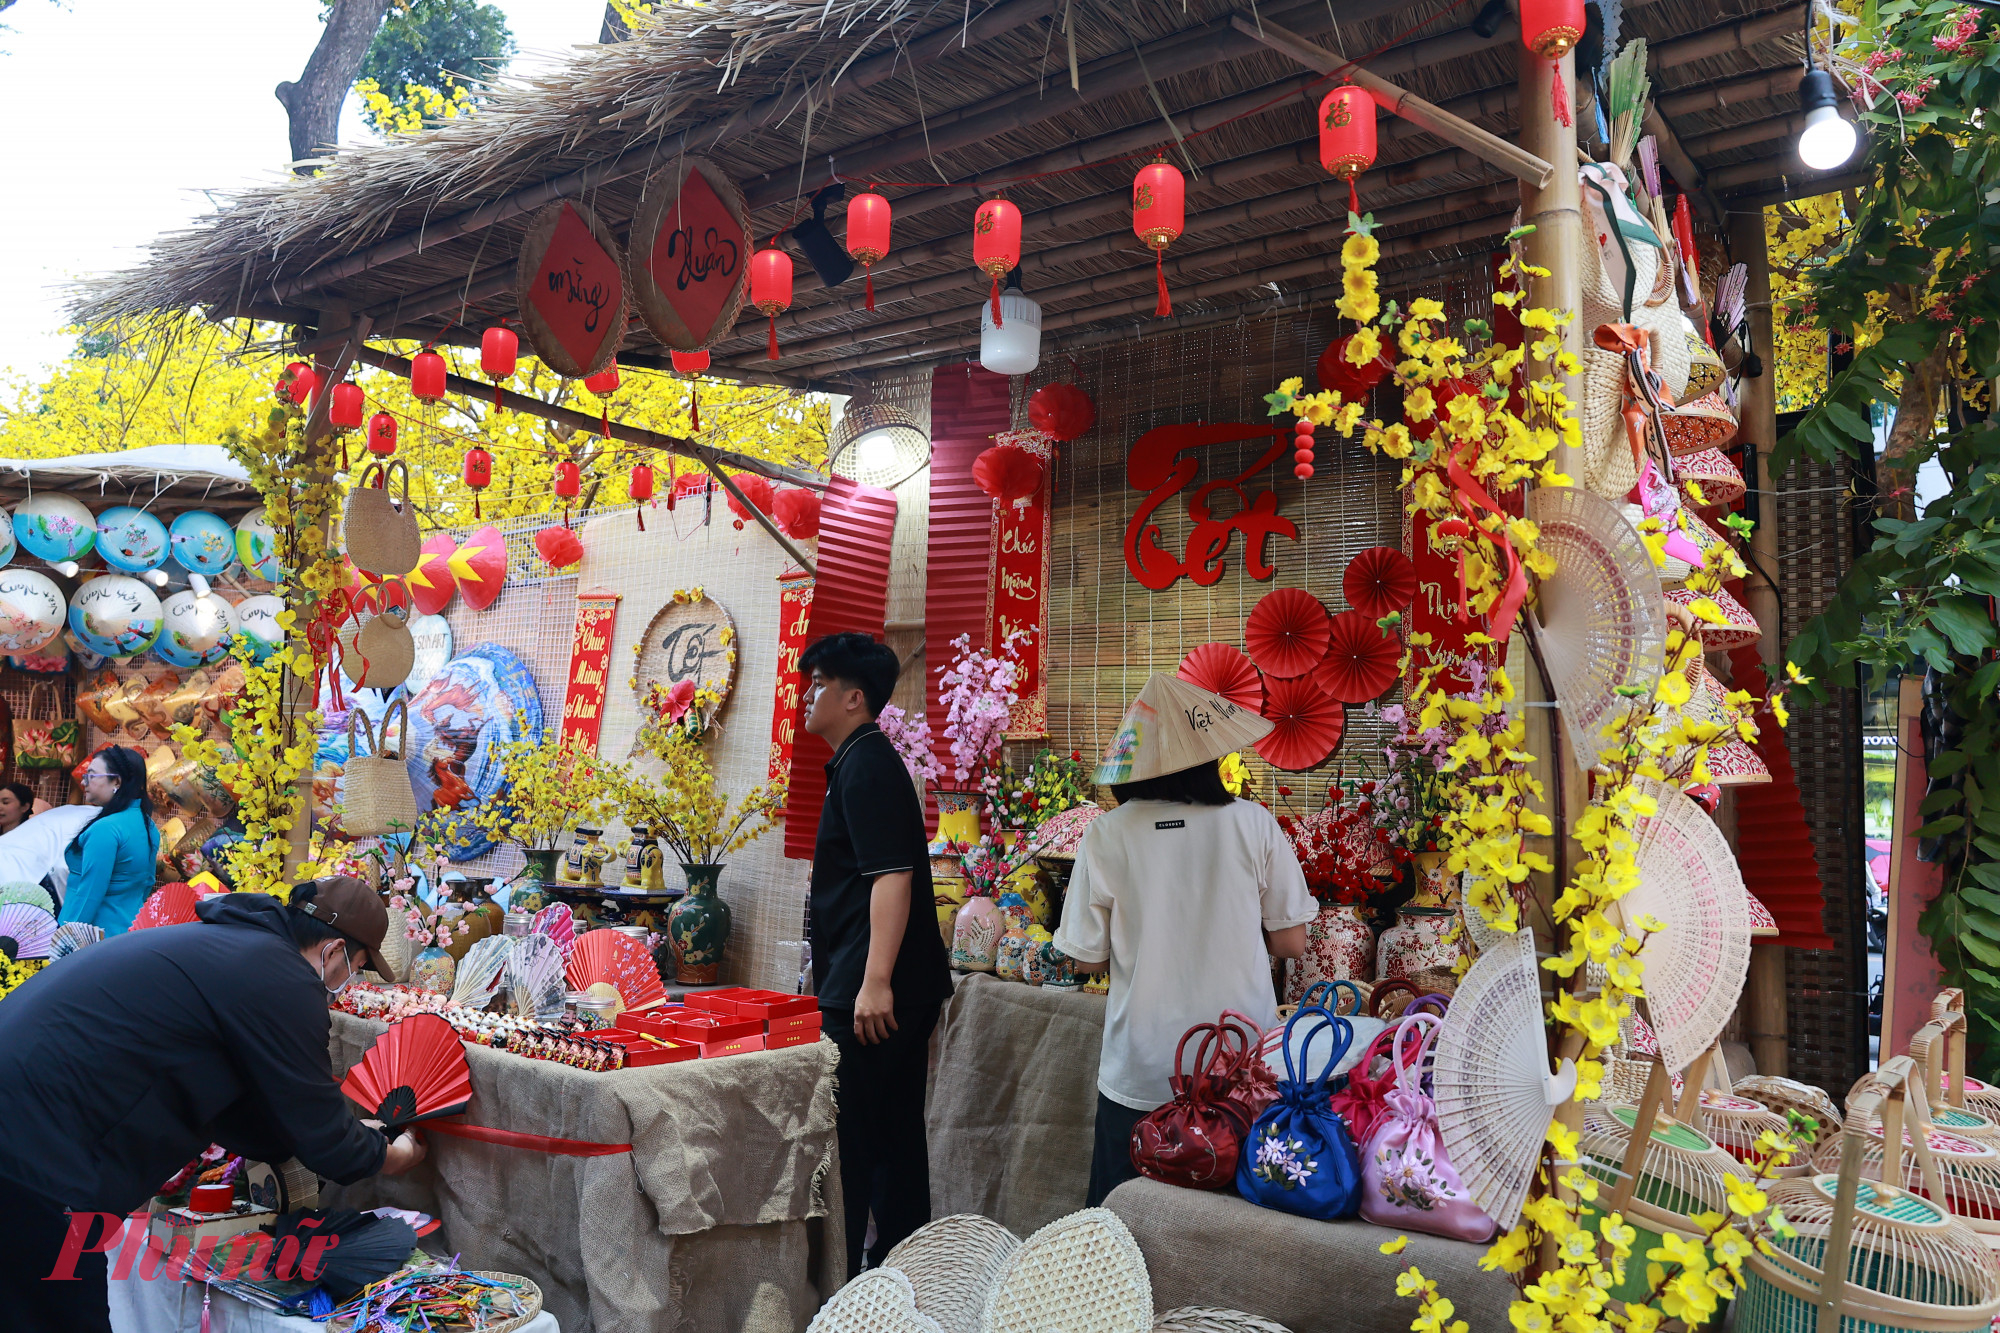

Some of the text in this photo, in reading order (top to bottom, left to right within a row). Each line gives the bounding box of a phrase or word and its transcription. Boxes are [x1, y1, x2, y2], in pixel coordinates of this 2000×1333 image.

[582, 626, 606, 652] Chúc
[662, 623, 725, 686] Tết
[572, 693, 597, 719] Năm
[1185, 705, 1214, 732] Việt
